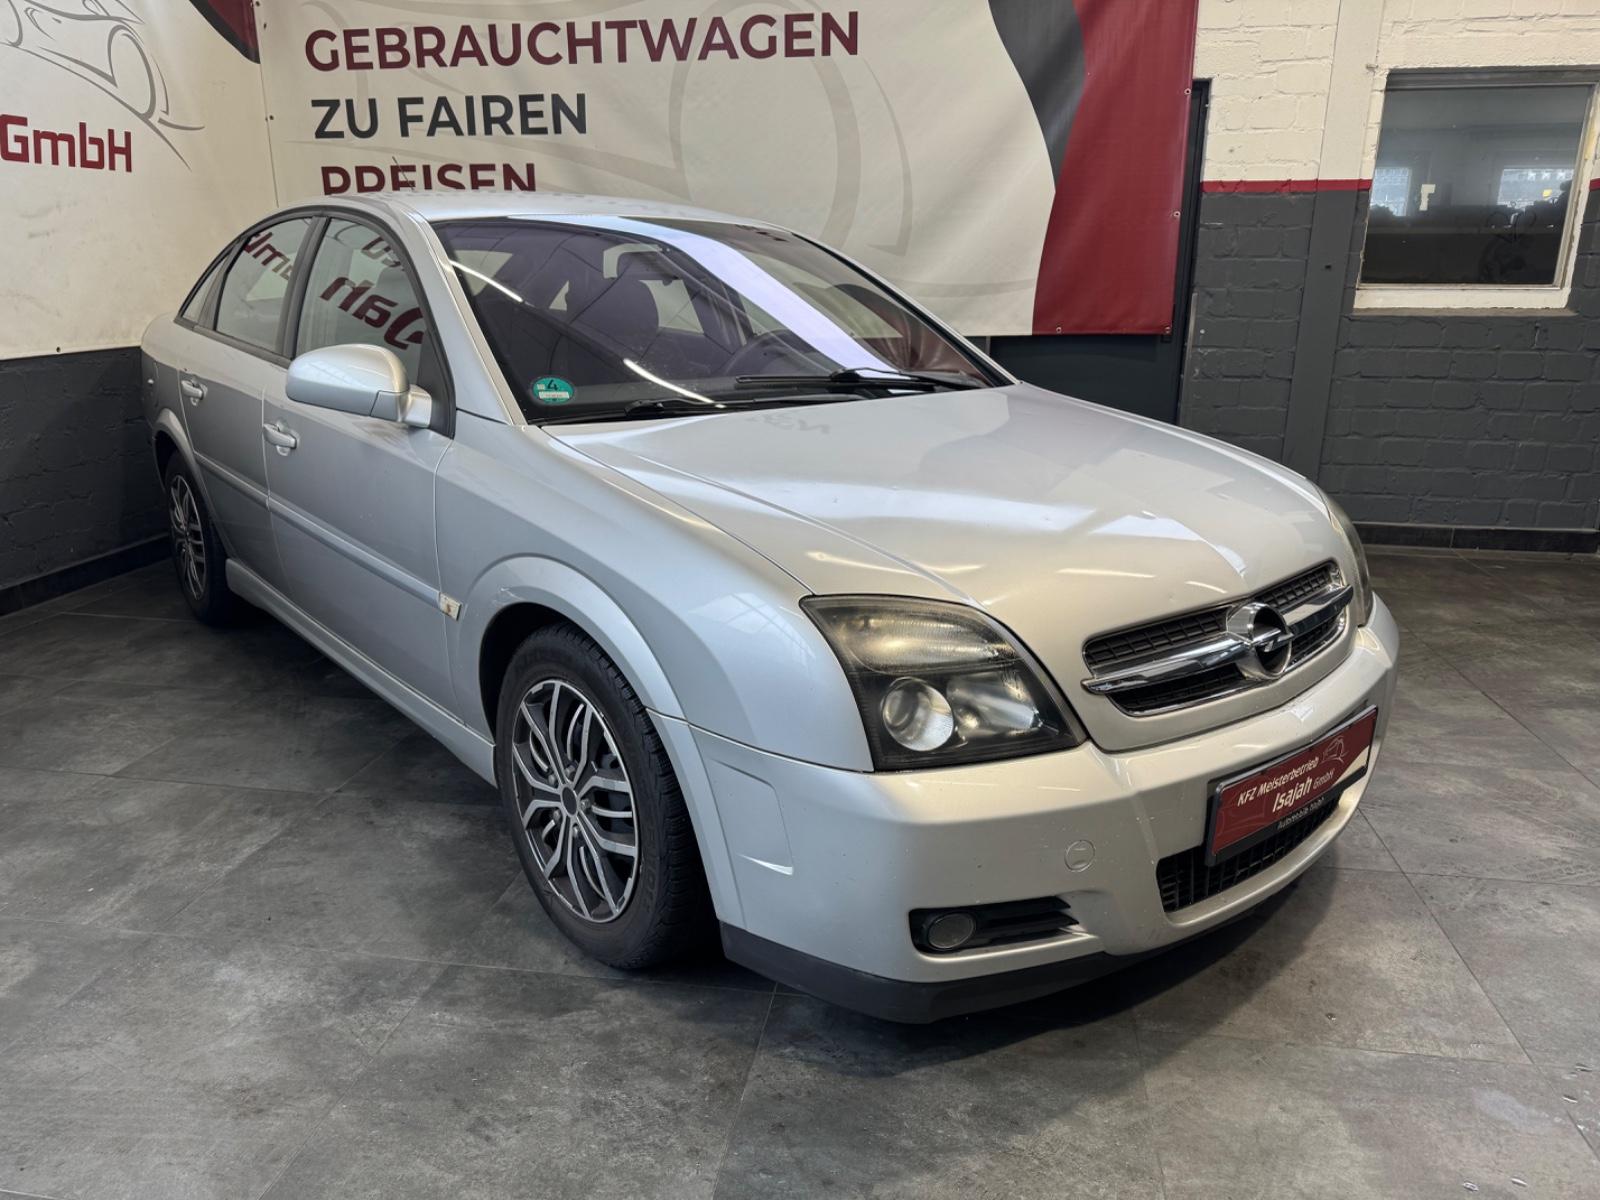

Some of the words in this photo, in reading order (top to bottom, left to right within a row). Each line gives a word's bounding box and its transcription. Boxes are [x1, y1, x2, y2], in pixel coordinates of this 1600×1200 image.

[304, 10, 859, 72] GEBRAUCHTWAGEN
[310, 97, 379, 140] ZU
[397, 92, 587, 138] FAIREN
[0, 114, 132, 173] GmbH
[547, 379, 559, 391] 4
[1237, 786, 1258, 807] KFZ
[1256, 756, 1320, 798] Meisterbetrieb
[1272, 776, 1313, 813] Isajah
[1313, 768, 1335, 790] GmbH
